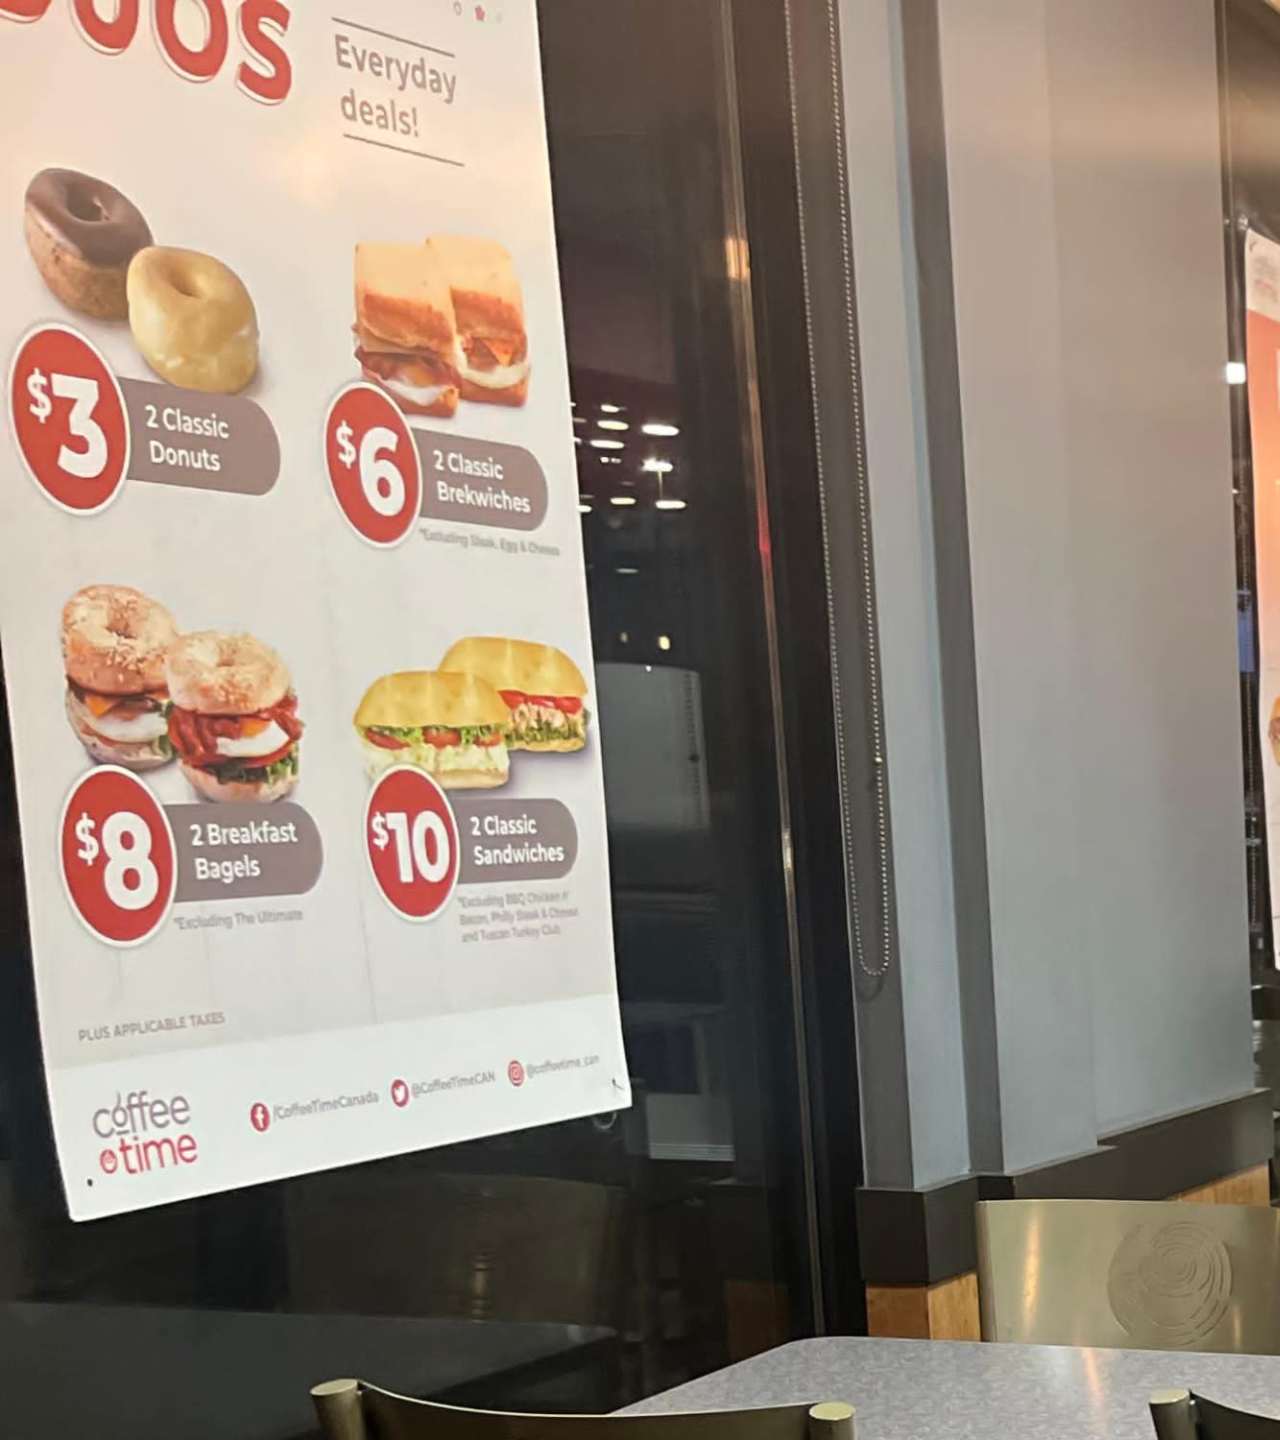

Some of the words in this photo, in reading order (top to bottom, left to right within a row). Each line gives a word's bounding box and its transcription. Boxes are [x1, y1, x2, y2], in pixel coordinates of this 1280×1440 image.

[334, 34, 456, 104] Everyday
[340, 88, 419, 137] deals!
[26, 367, 108, 479] $3
[145, 405, 158, 428] 2
[162, 407, 229, 439] Classic
[149, 440, 221, 471] Donuts
[335, 420, 405, 516] $6
[433, 450, 444, 470] 2
[447, 453, 504, 480] Classic
[436, 481, 532, 513] Brekwiches
[190, 824, 203, 846] 2
[206, 820, 298, 845] Breakfast
[470, 816, 481, 836] 2
[484, 814, 538, 835] Classic
[75, 811, 159, 910] $8
[371, 810, 450, 883] $10
[473, 843, 565, 865] Sandwiches
[194, 854, 261, 883] Bagels
[78, 1028, 111, 1042] PLUS
[113, 1016, 188, 1037] APPLICABLE
[189, 1012, 227, 1028] TAXES
[92, 1091, 192, 1138] coffee
[119, 1133, 199, 1175] time
